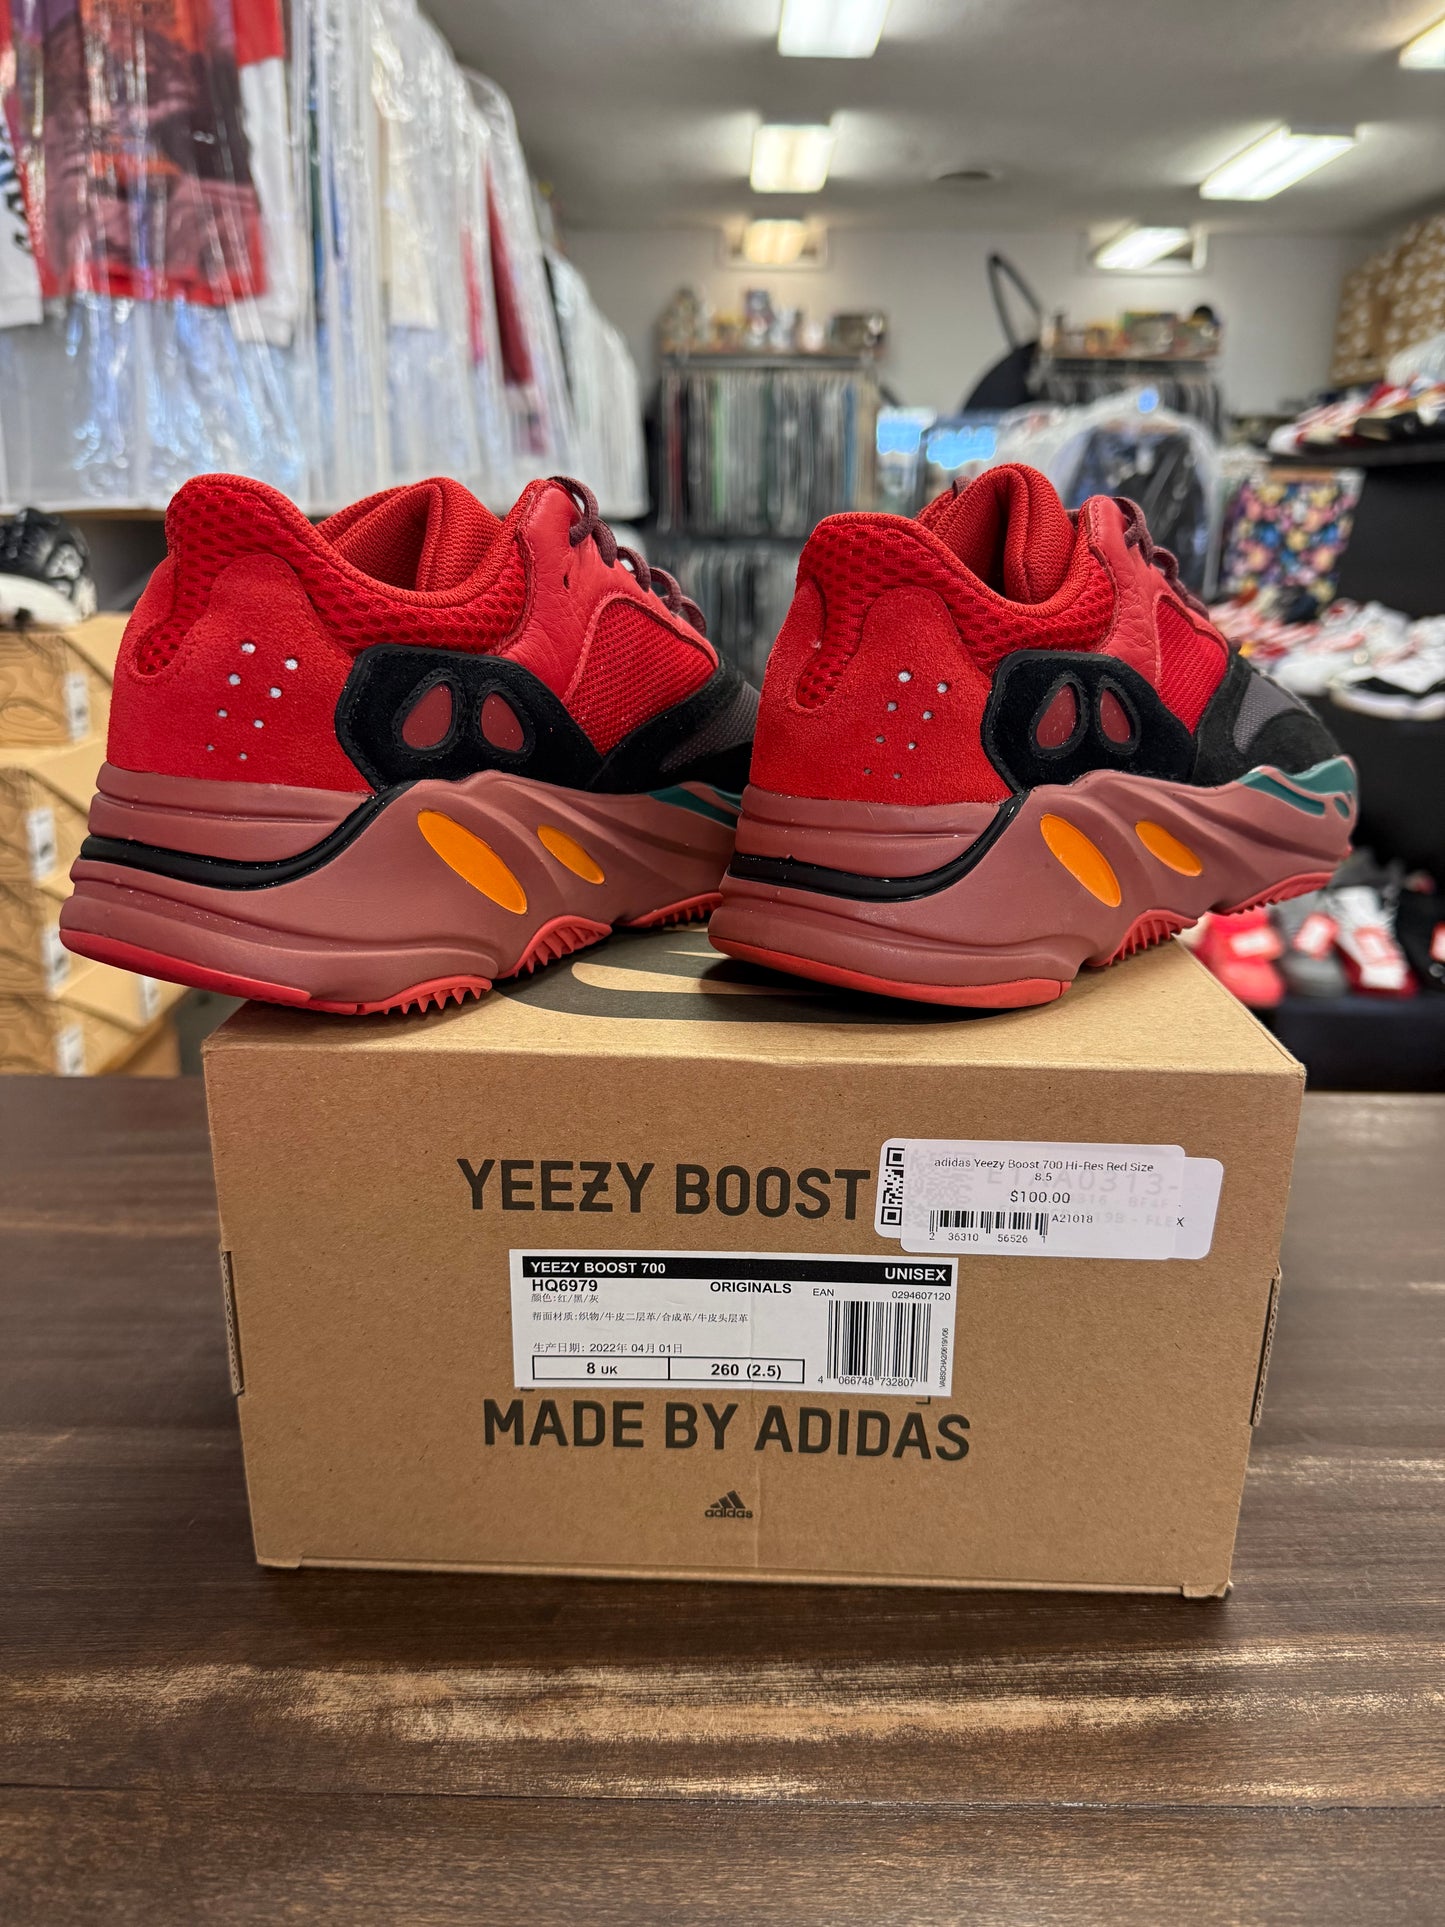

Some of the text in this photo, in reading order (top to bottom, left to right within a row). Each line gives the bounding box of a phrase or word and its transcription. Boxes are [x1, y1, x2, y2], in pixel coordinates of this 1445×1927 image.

[934, 1158, 1154, 1172] adidas Yeezy Boost 700 Hi-Res Red Size
[1034, 1172, 1052, 1181] 8.5
[457, 1158, 871, 1220] YEEZY BOOST
[1010, 1190, 1071, 1205] $100.00
[1052, 1214, 1093, 1224] A21018
[929, 1232, 935, 1241] 2
[948, 1233, 979, 1242] 36310
[997, 1234, 1028, 1243] 56526
[530, 1261, 666, 1274] YEEZY BOOST 700
[884, 1267, 947, 1281] UNISEX
[532, 1279, 598, 1292] HQ6979
[710, 1281, 792, 1294] ORIGINALS
[812, 1288, 834, 1297] EAN
[892, 1290, 950, 1301] 0294607120
[589, 1343, 628, 1353] 2022年
[586, 1362, 618, 1375] 8 UK
[711, 1364, 782, 1380] 260 (2.5)
[818, 1376, 915, 1387] 4 066748 732807
[483, 1398, 970, 1461] MADE BY ADIDAS
[704, 1507, 753, 1518] adidas
